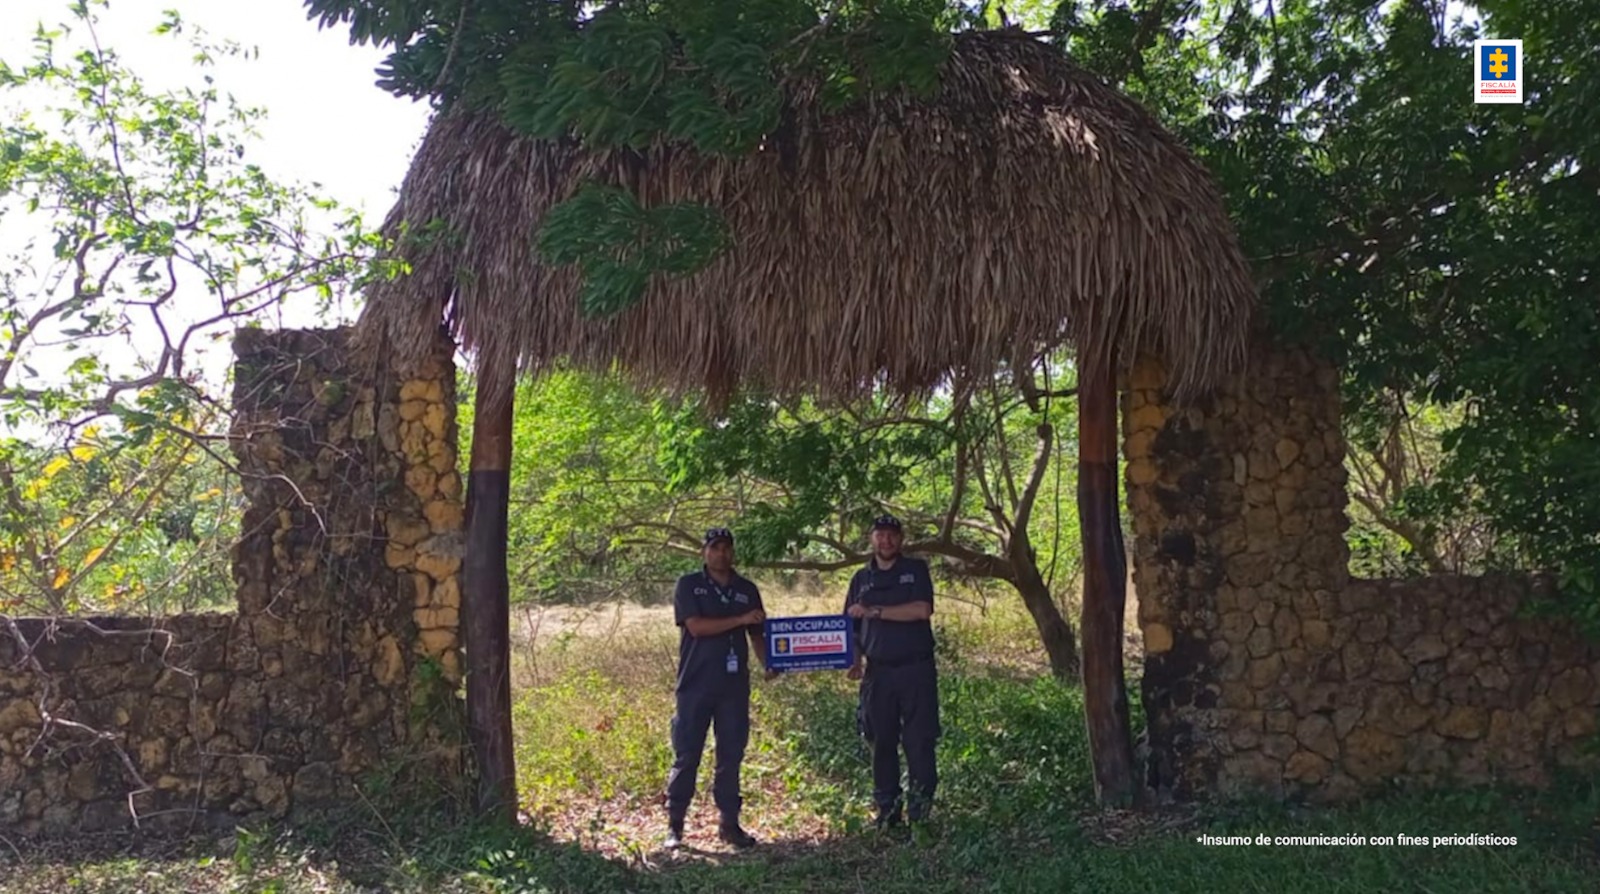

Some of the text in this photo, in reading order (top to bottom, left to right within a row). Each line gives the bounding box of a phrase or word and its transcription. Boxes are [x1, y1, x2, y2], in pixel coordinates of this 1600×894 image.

[771, 619, 847, 633] BIEN OCUPADO
[792, 633, 843, 645] FISCALÍA
